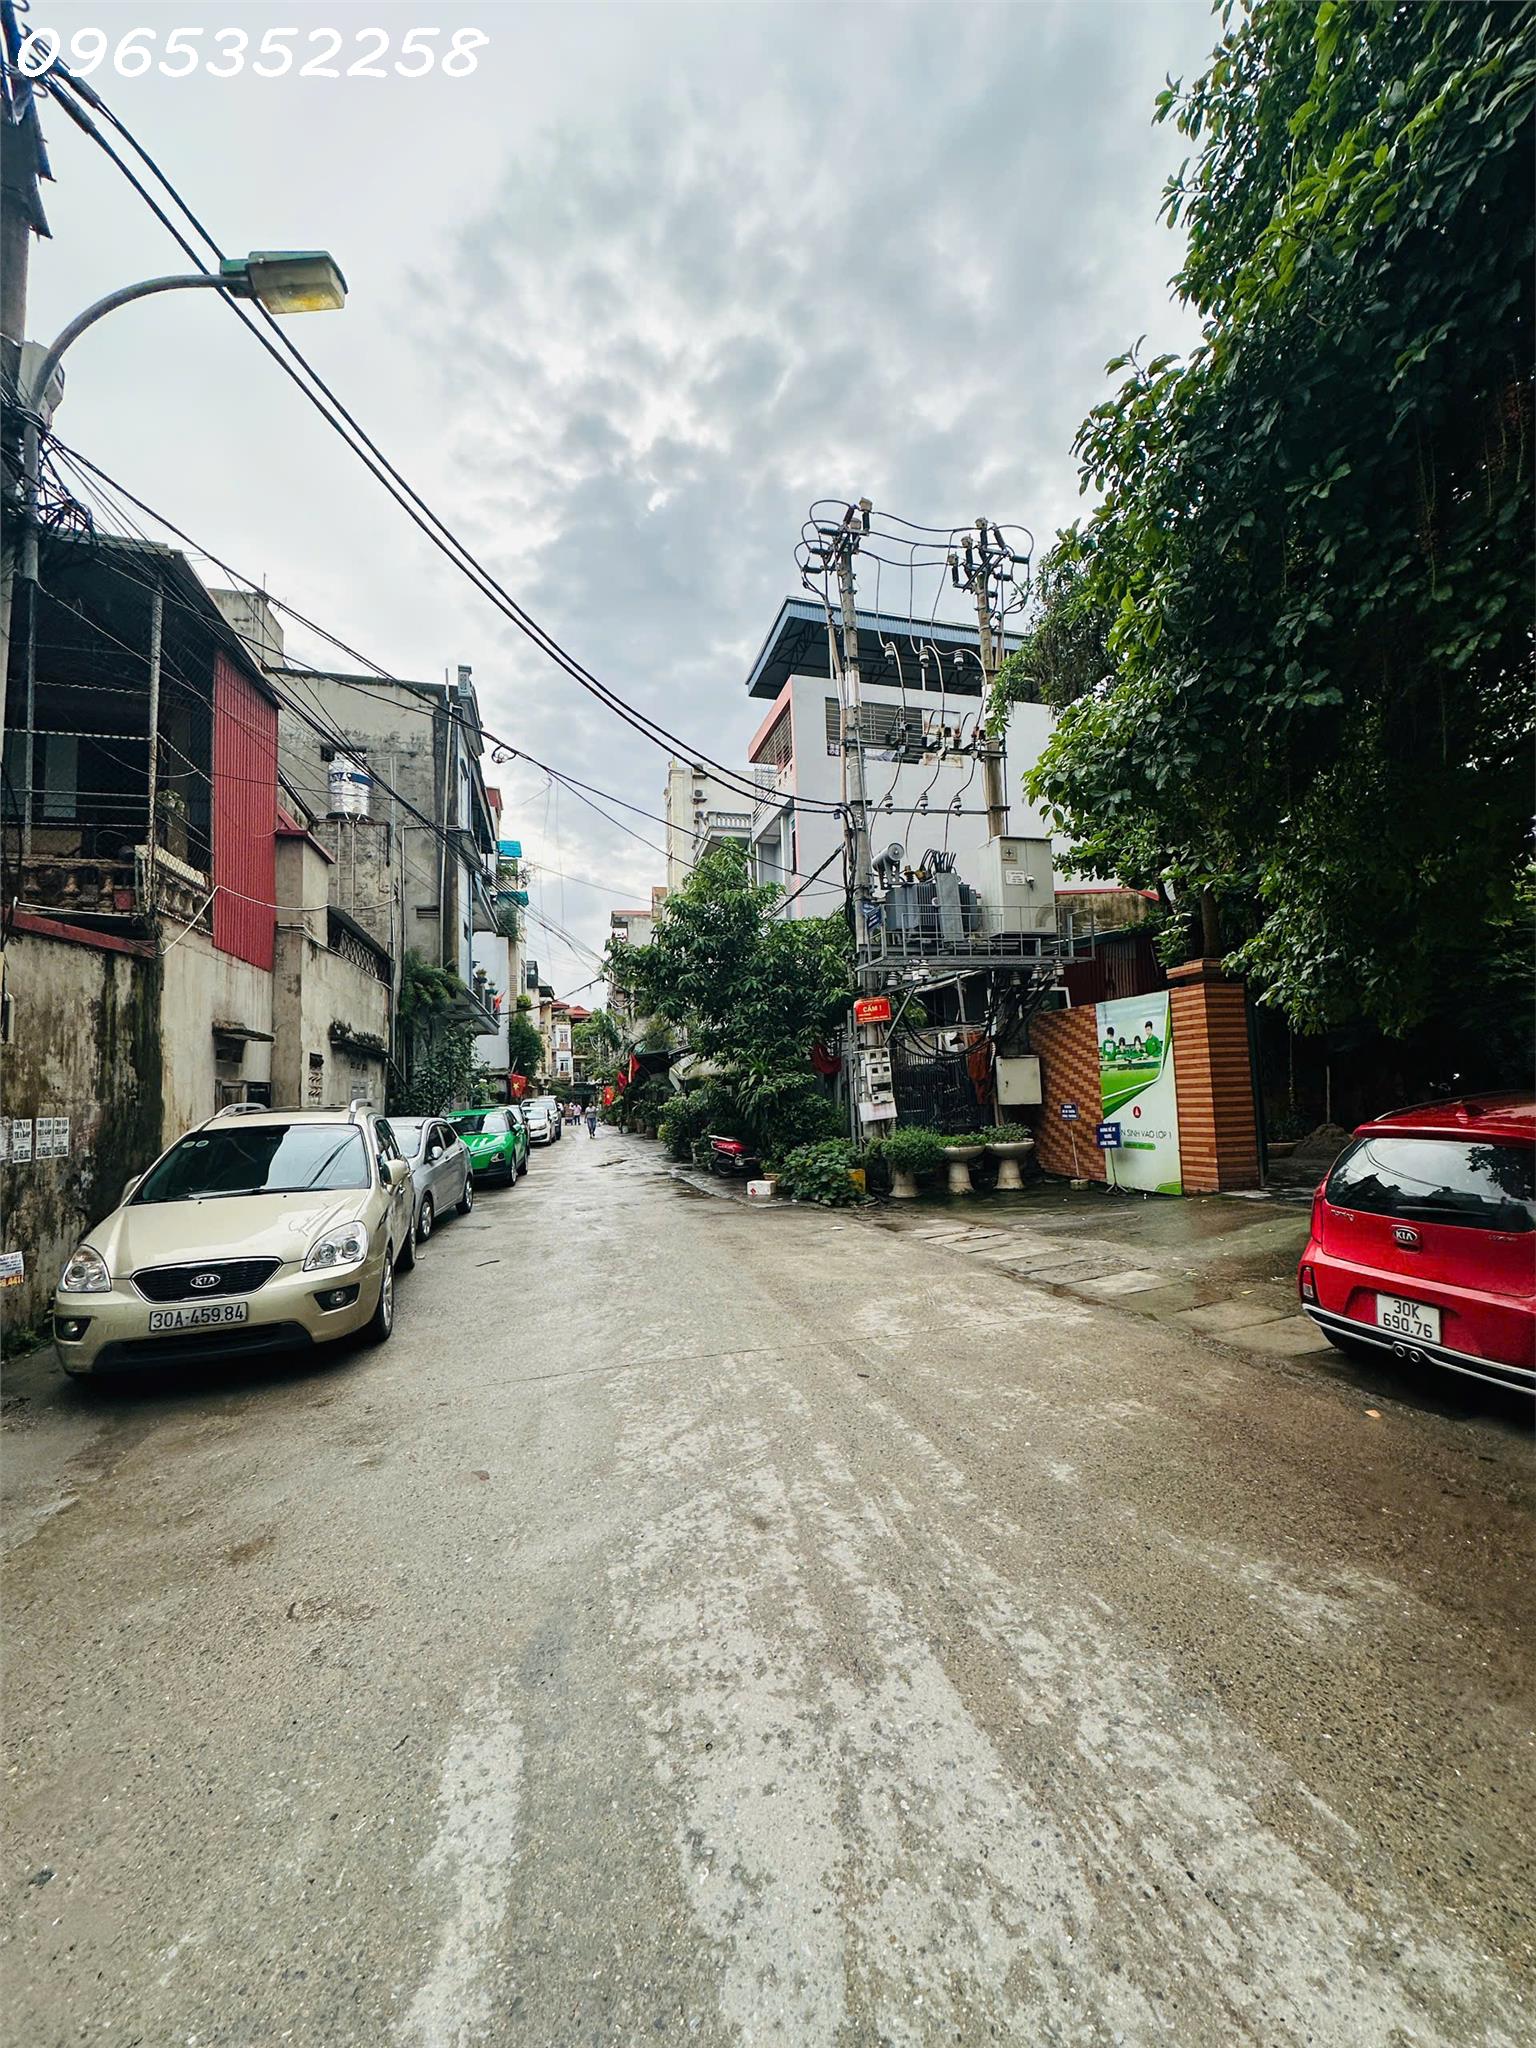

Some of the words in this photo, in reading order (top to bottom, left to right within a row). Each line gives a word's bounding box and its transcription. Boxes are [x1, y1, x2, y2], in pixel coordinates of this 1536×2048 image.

[1395, 1230, 1413, 1241] KIA
[194, 1276, 216, 1286] KIA
[153, 1305, 244, 1328] 30A-459.84
[1393, 1300, 1420, 1320] 30K
[1383, 1313, 1433, 1339] 690.76
